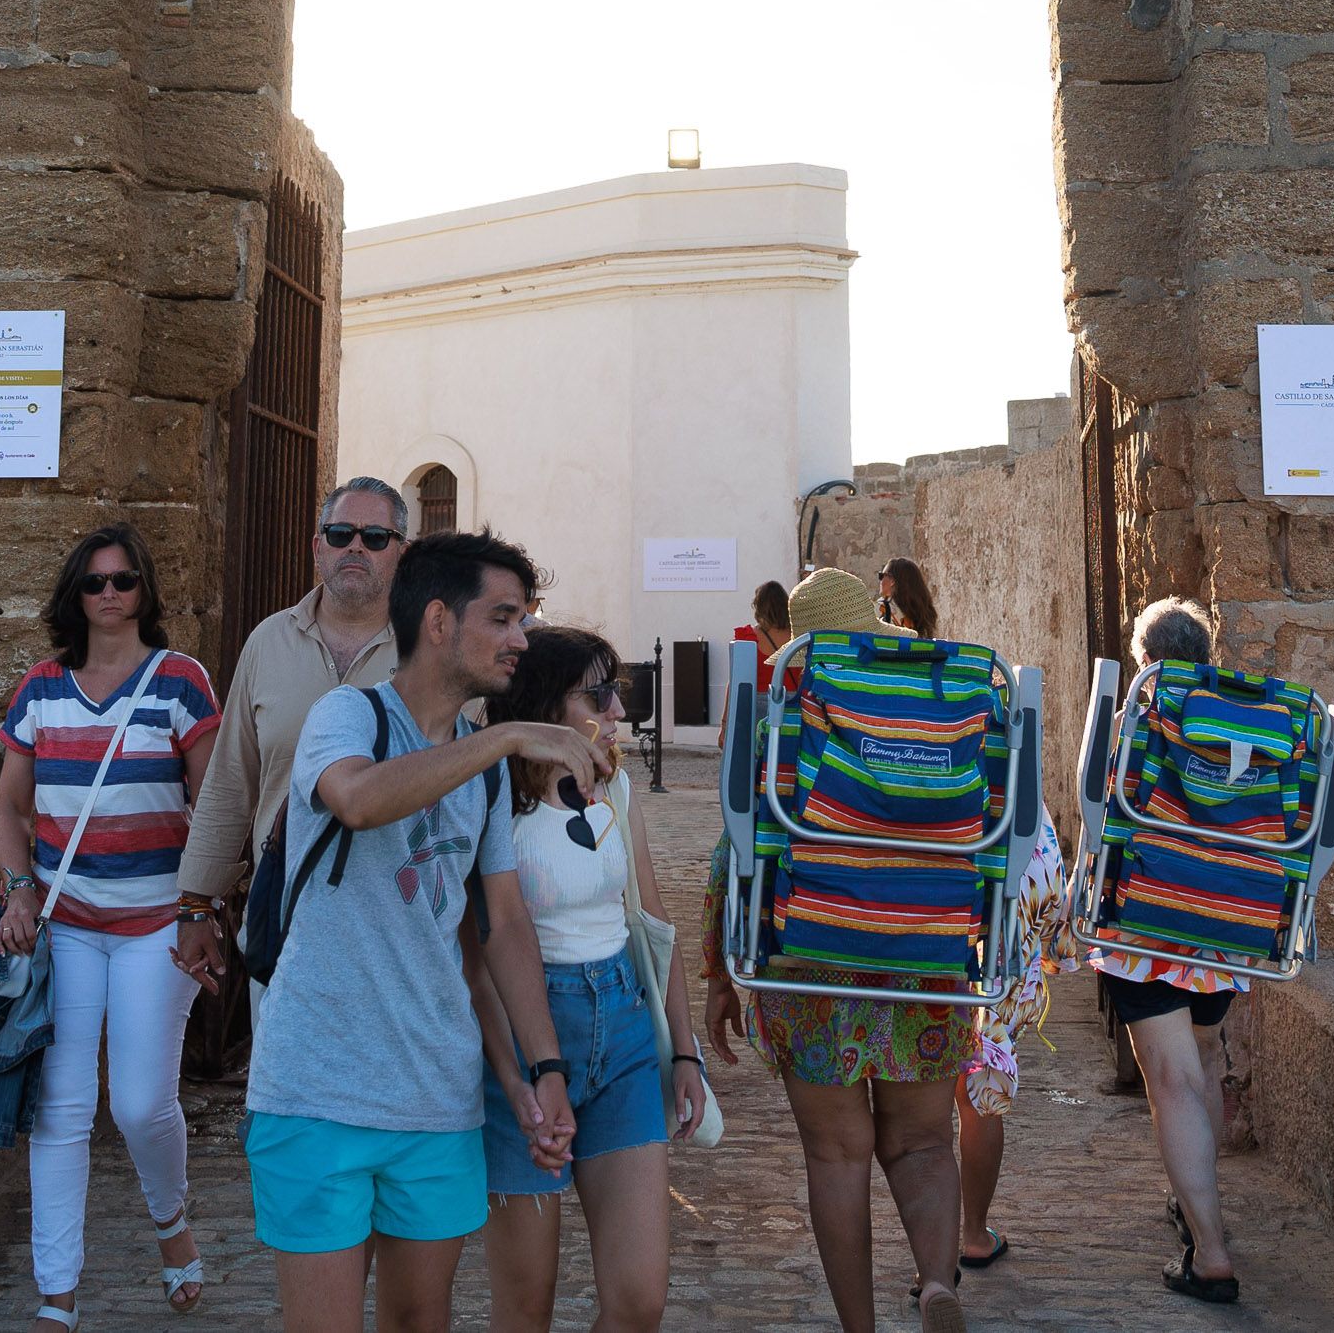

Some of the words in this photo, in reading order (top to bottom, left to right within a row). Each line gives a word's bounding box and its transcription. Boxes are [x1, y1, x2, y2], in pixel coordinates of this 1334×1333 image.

[8, 343, 44, 352] SEBASTIÁN
[1274, 392, 1312, 400] CASTILLO
[863, 742, 902, 761] Tommy
[901, 748, 948, 762] Bahama
